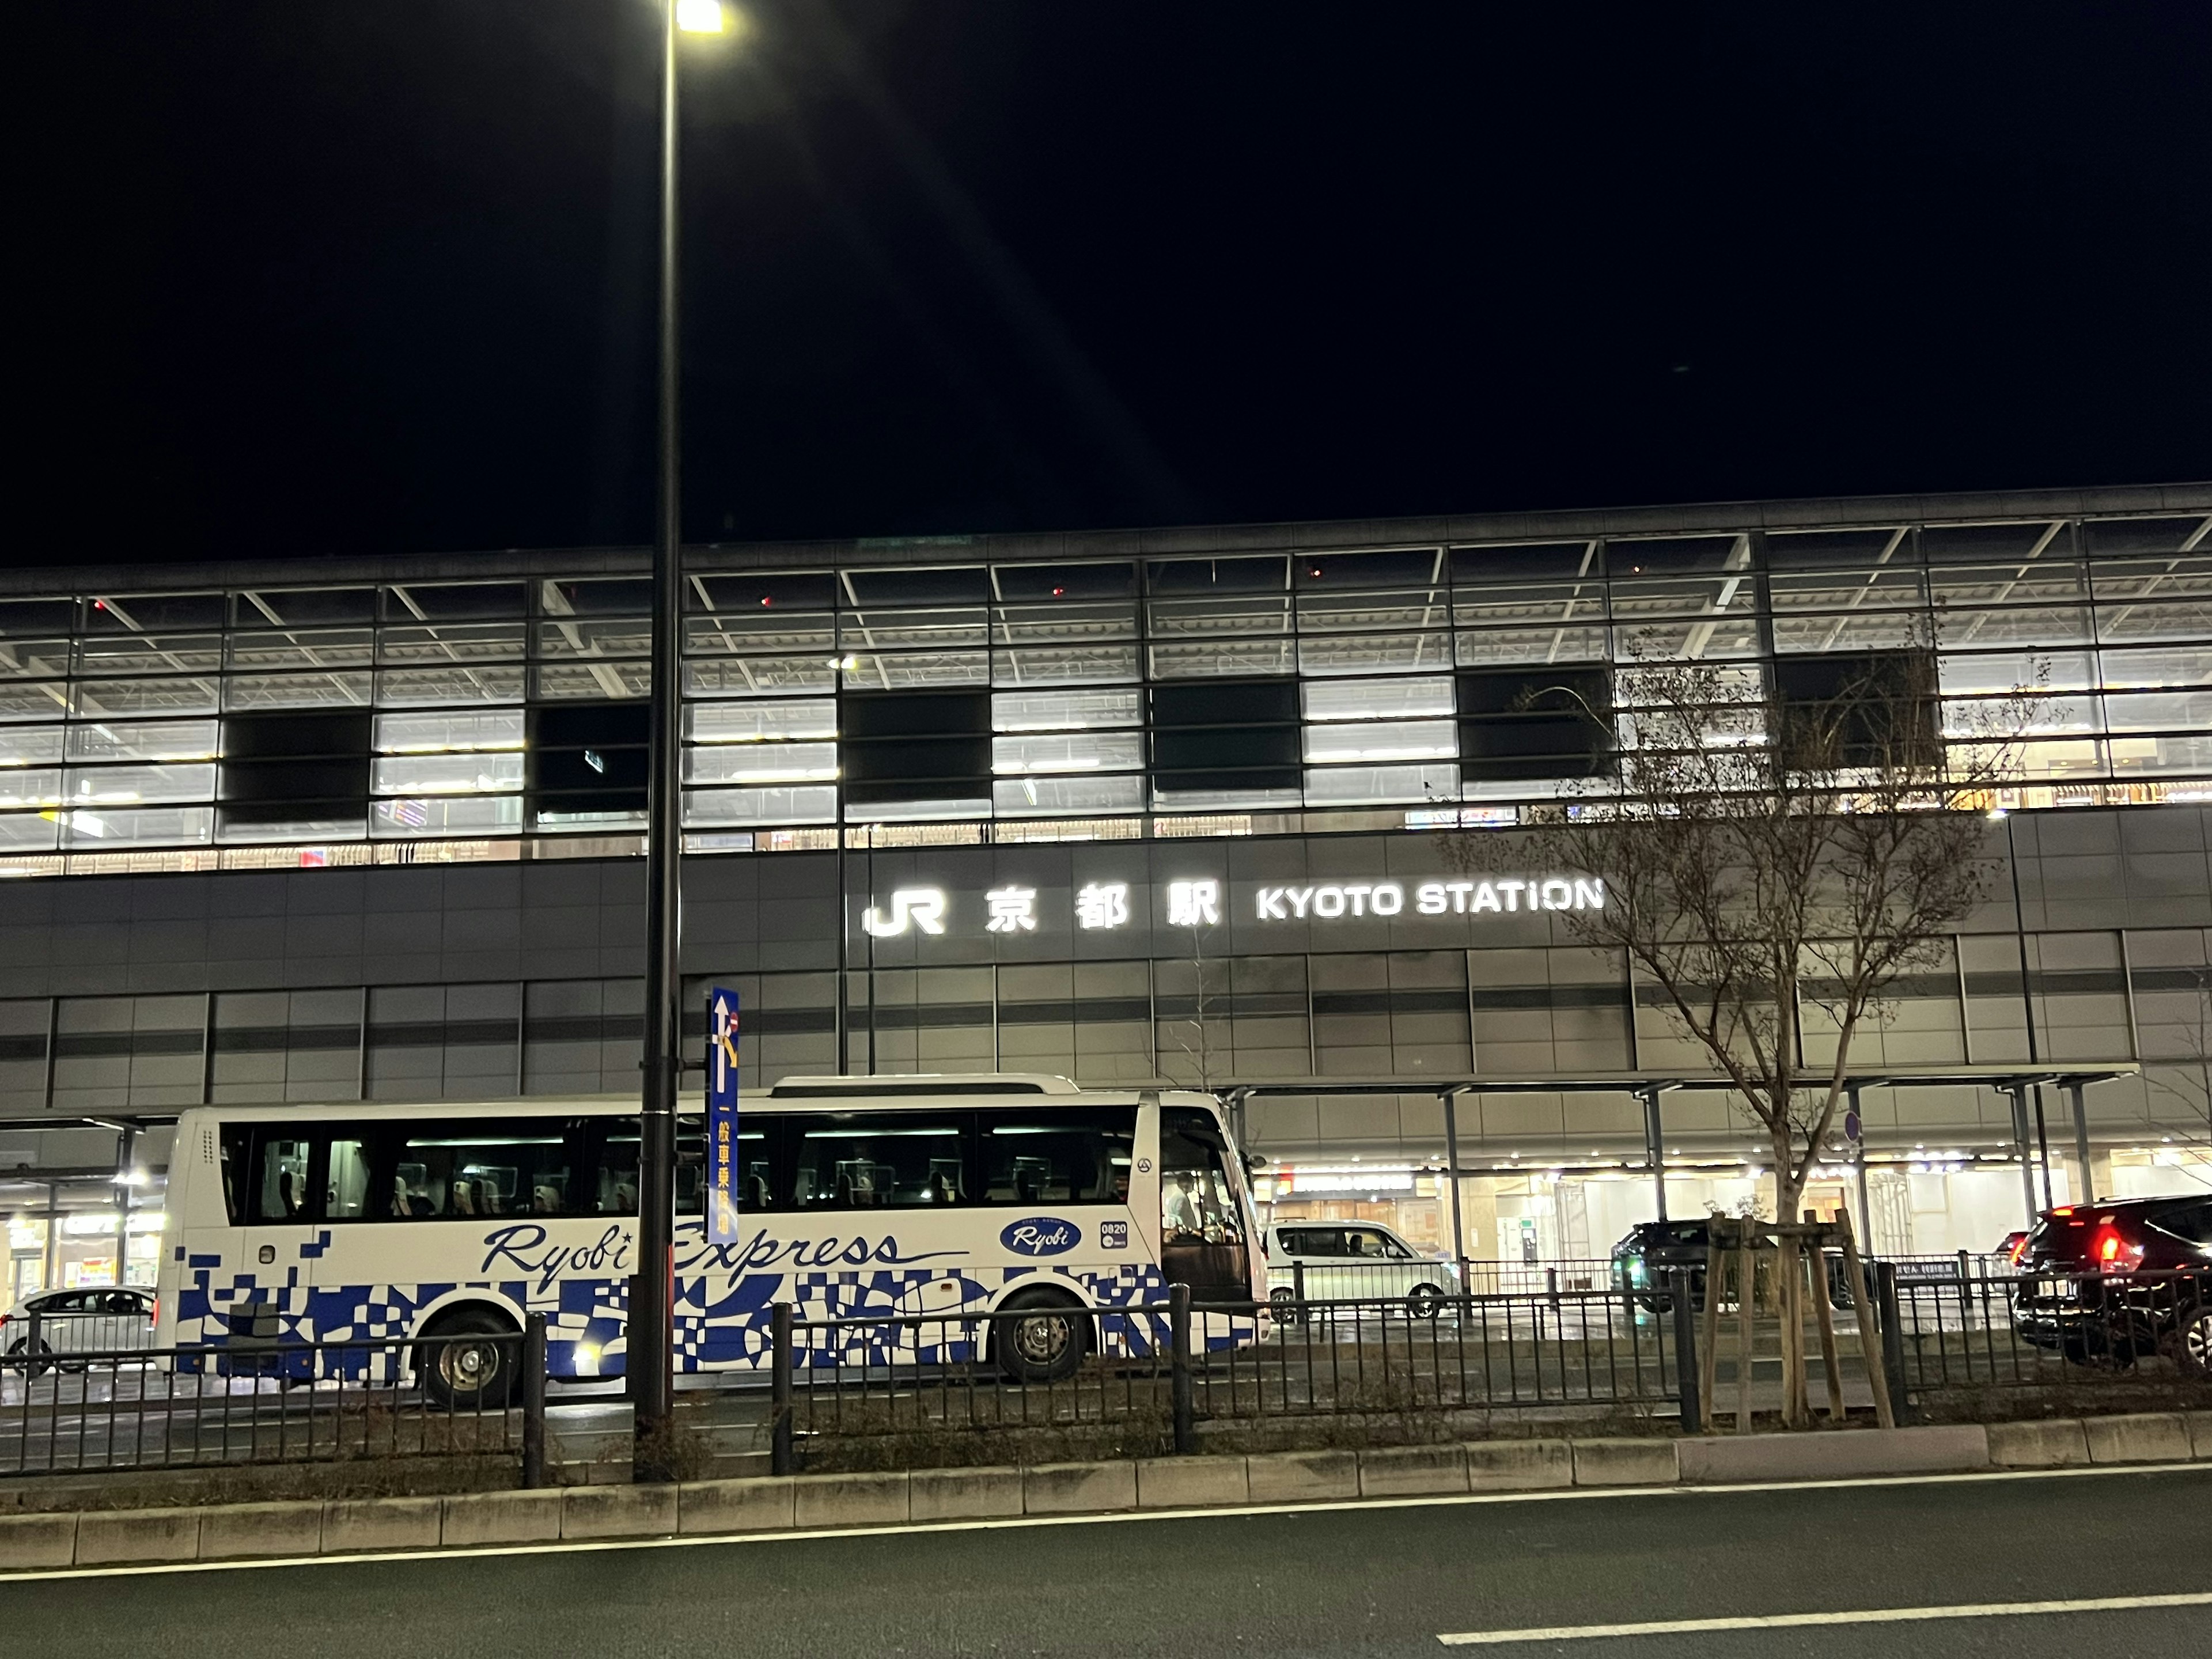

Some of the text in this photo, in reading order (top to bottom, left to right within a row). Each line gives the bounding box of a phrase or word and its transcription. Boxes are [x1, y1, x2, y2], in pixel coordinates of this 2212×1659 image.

[863, 878, 1603, 937] JR 京都駅 KYOTO STATION
[1013, 1226, 1069, 1255] Ryobi
[1101, 1224, 1127, 1234] 0820
[481, 1221, 970, 1295] Ryobi Express
